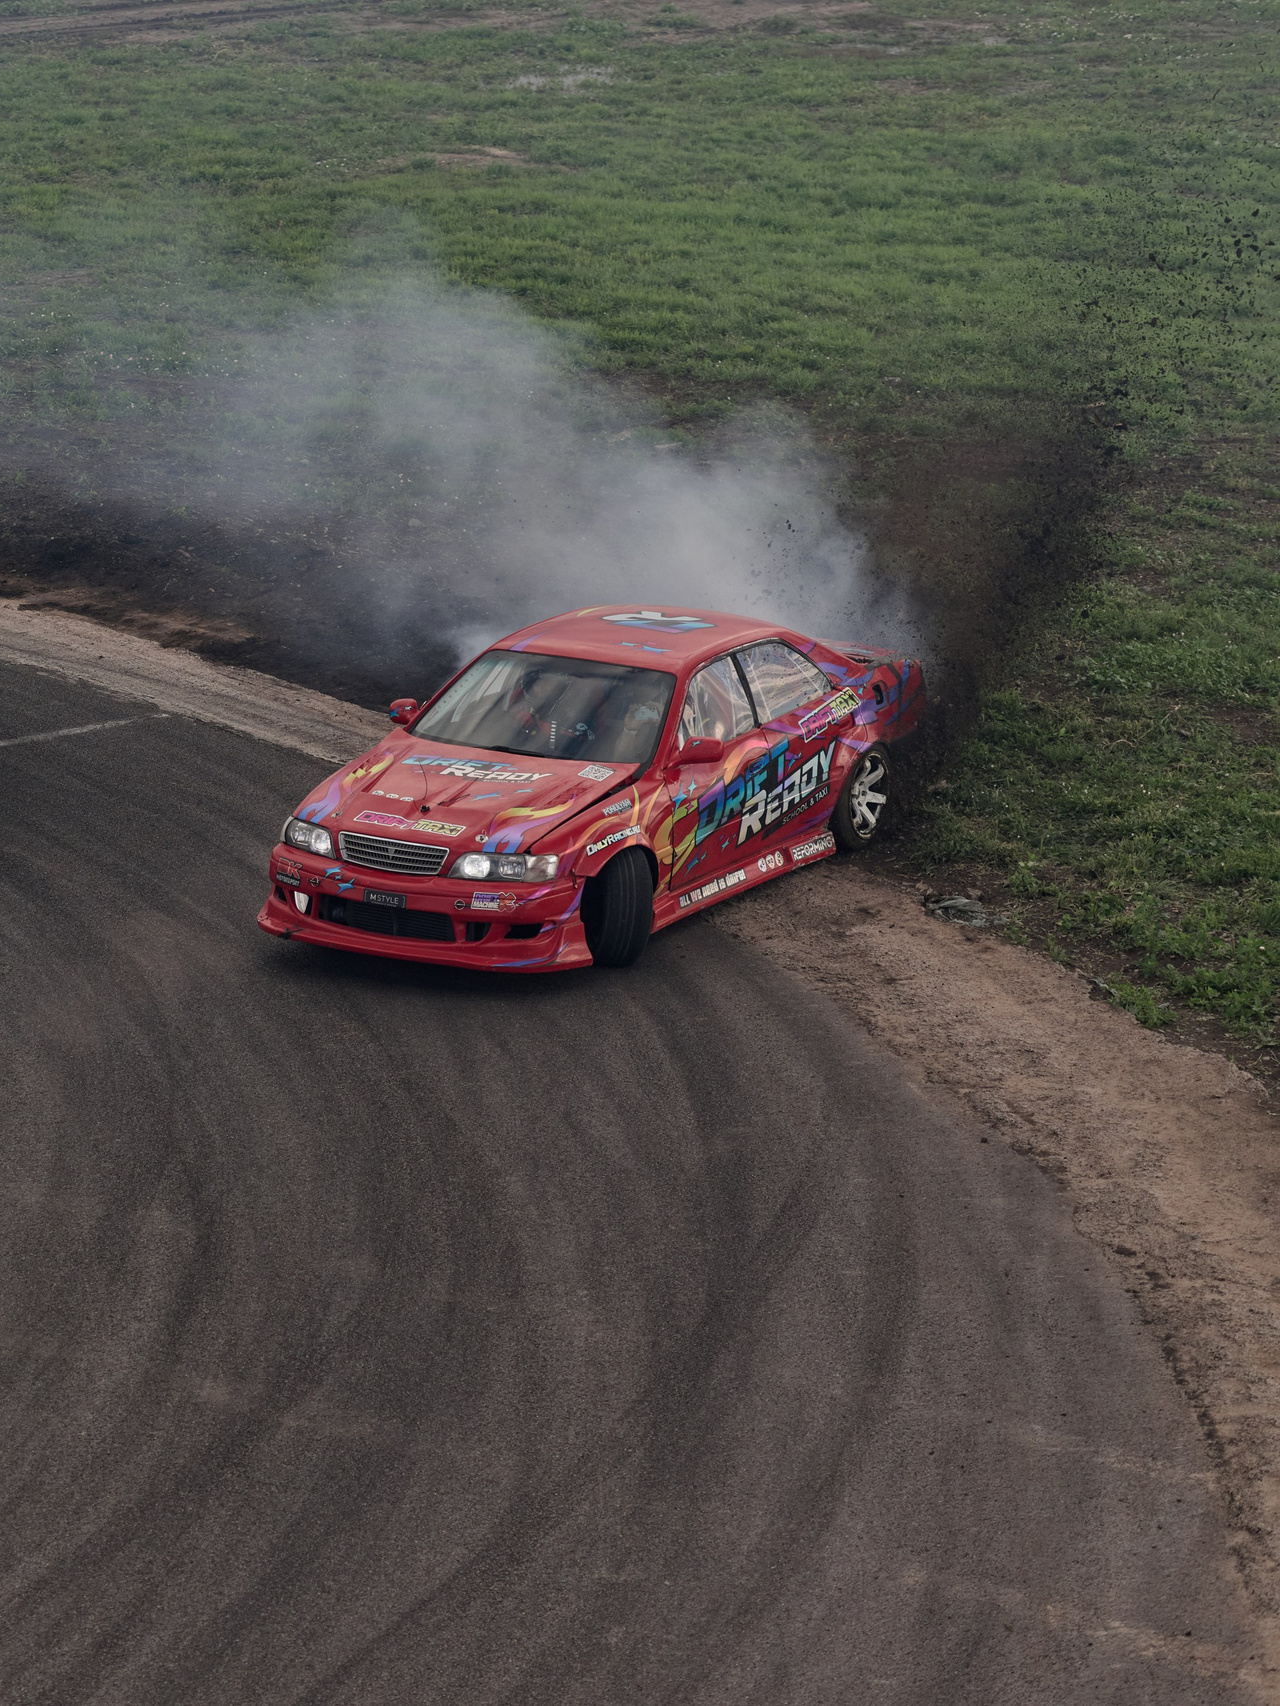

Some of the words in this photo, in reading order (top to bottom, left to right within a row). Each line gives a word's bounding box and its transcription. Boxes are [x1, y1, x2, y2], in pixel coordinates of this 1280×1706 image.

[401, 755, 511, 771] DRIFT
[440, 765, 554, 781] READY
[696, 737, 789, 845] DRIFT
[737, 740, 838, 847] READY
[782, 803, 809, 825] SCHOOL
[815, 786, 829, 803] TAXI
